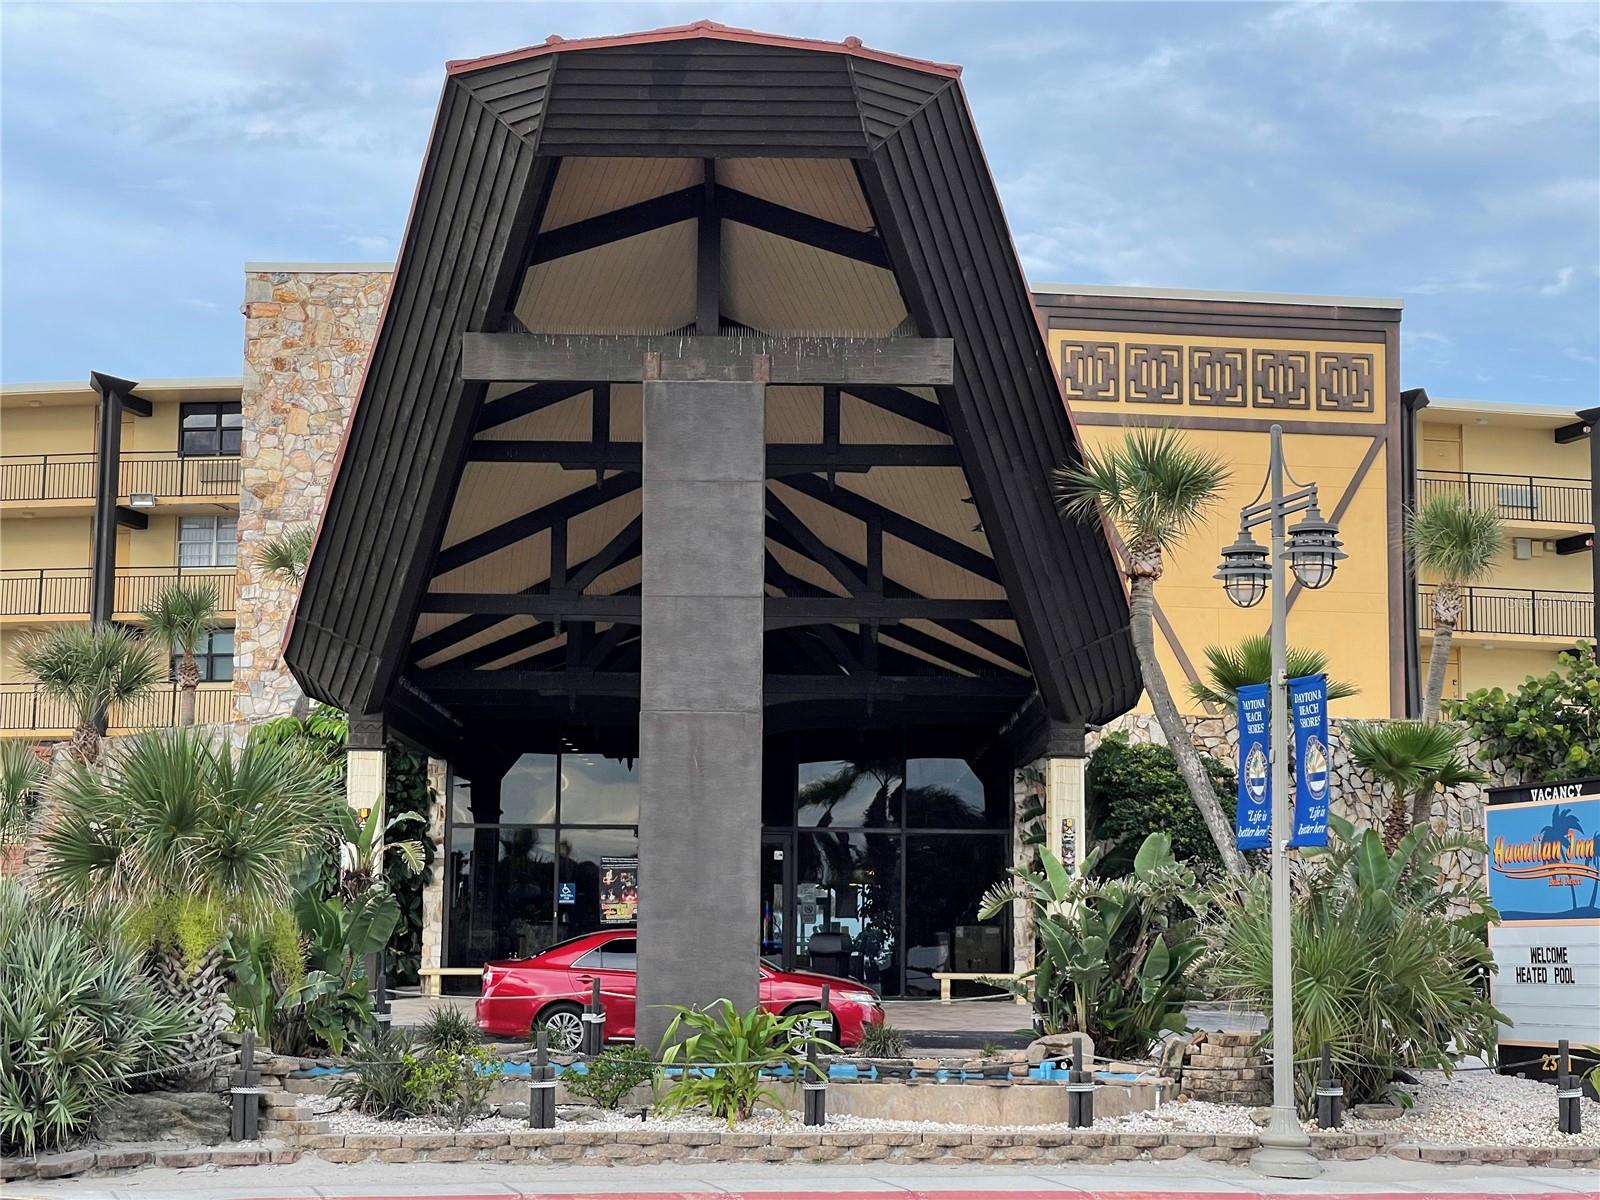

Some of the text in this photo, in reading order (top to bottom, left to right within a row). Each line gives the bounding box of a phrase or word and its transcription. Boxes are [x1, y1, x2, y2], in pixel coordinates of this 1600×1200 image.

[1294, 689, 1322, 704] DAYTONA
[1530, 784, 1583, 802] VACANCY
[1493, 829, 1594, 870] Hawaiian Inn
[1530, 946, 1568, 965] WELCOME
[1515, 967, 1576, 984] HEATED POOL
[1542, 1054, 1572, 1073] 231
